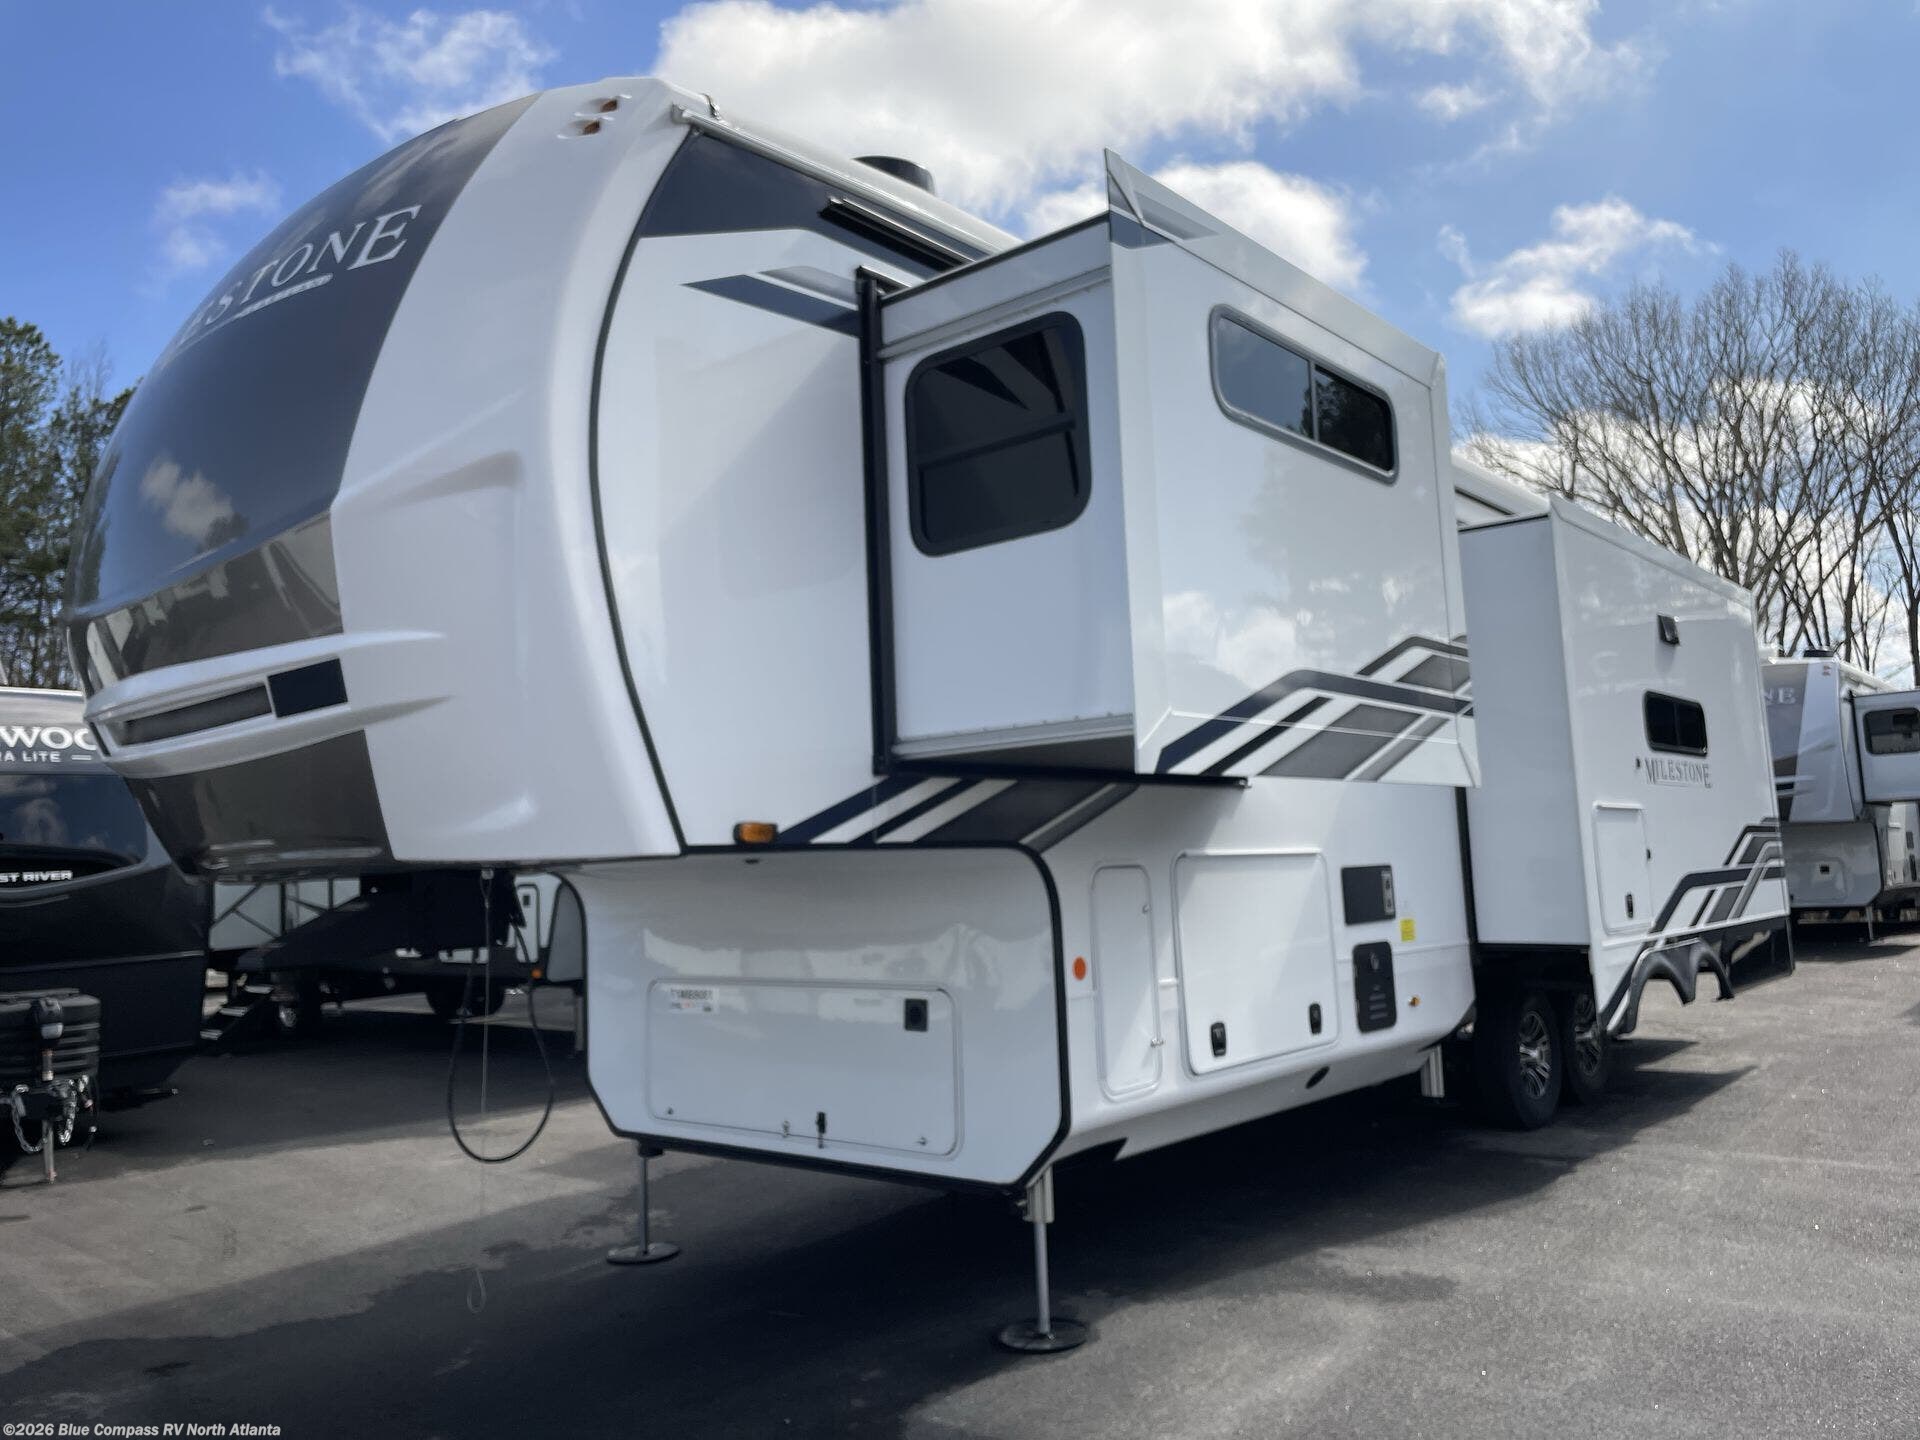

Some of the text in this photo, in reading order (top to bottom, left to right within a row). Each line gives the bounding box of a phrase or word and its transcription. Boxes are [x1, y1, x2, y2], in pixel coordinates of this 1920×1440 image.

[22, 750, 61, 763] LITE
[1644, 758, 1711, 789] MILESTONE
[22, 870, 73, 882] RIVER
